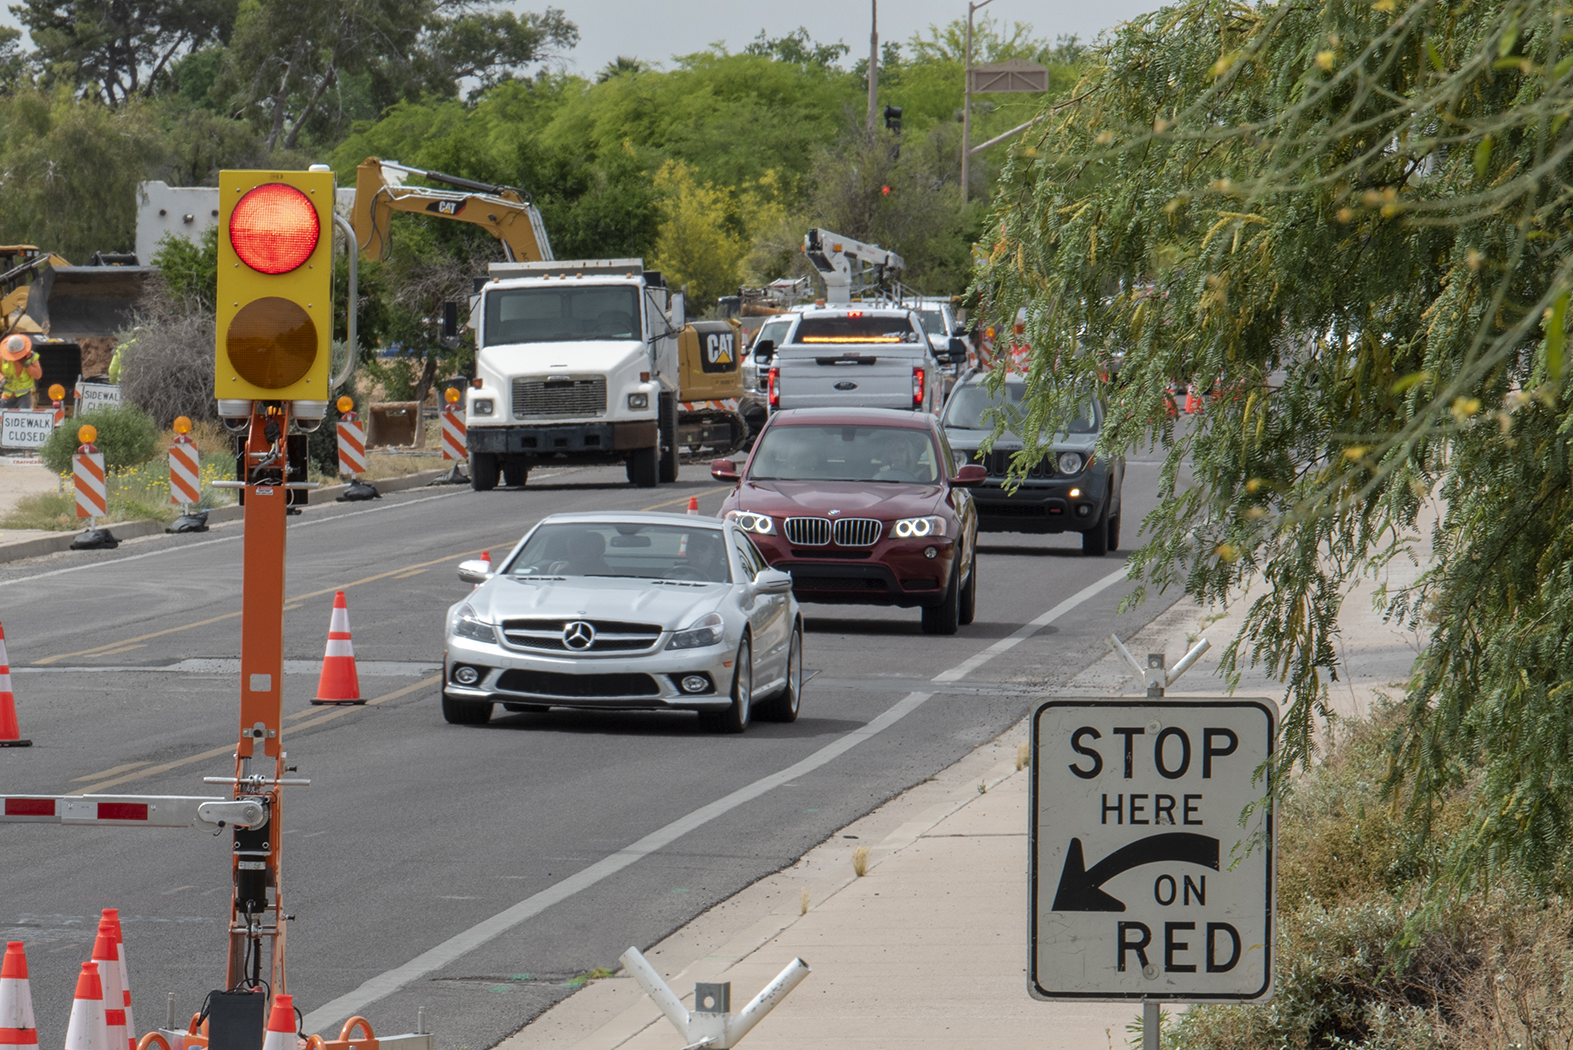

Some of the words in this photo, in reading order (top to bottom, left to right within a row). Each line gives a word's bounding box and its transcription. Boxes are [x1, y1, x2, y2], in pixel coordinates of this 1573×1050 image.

[439, 200, 456, 214] CAT
[707, 333, 733, 363] CAT
[5, 417, 51, 428] SIDEWALK
[8, 430, 46, 442] CLOSED
[1068, 726, 1239, 780] STOP
[1101, 793, 1203, 825] HERE
[1153, 873, 1206, 906] ON
[1117, 920, 1242, 973] RED
